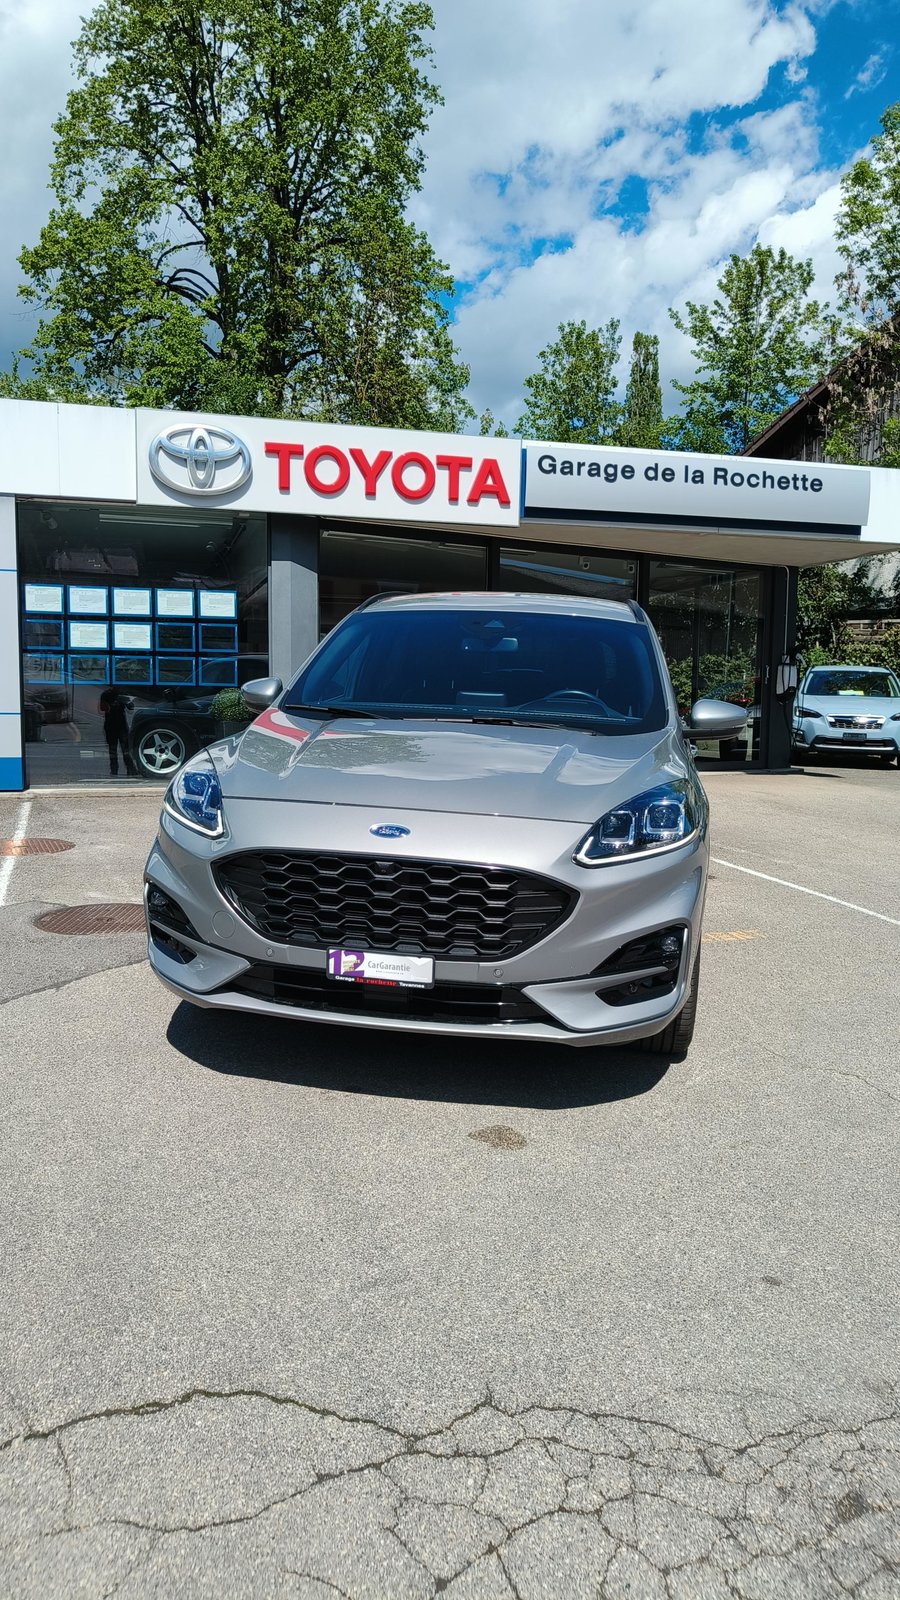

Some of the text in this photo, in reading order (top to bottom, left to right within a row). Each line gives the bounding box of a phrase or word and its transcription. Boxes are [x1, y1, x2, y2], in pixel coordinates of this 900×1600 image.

[264, 441, 510, 506] TOYOTA
[537, 454, 824, 493] Garage de la Rochette
[329, 950, 365, 977] 12
[367, 960, 411, 972] CarGarantie
